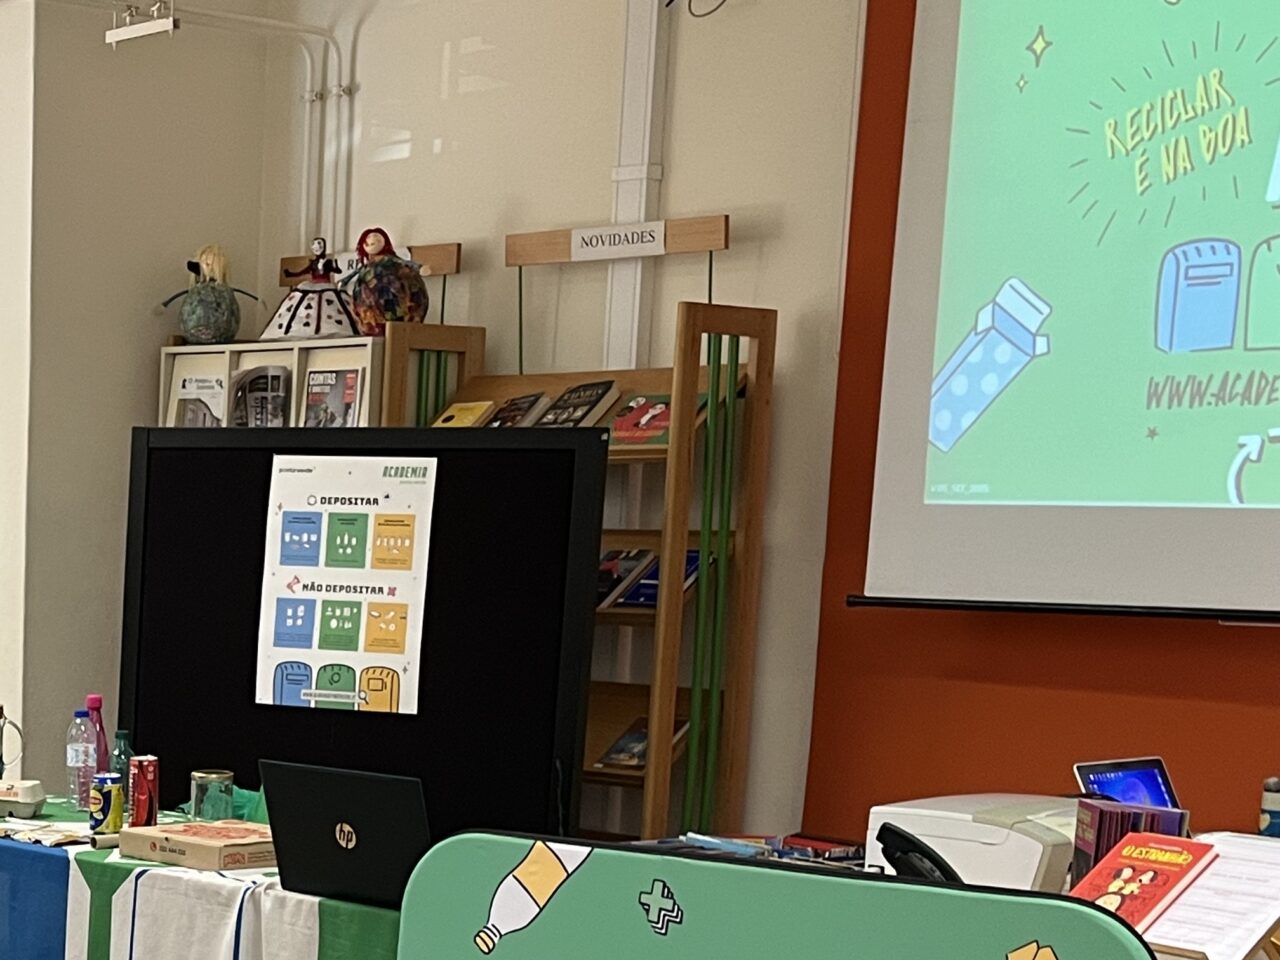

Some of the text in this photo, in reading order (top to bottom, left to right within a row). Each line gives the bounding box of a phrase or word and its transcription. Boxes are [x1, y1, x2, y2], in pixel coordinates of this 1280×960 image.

[1105, 68, 1236, 160] RECICLAR
[1161, 135, 1195, 185] NA
[1200, 105, 1253, 165] BOA
[580, 229, 657, 249] NOVIDADES
[382, 465, 429, 479] ACADEMIA
[320, 496, 380, 506] DEPOSITAR
[302, 581, 384, 595] NÃO DEPOSITAR
[337, 823, 354, 850] hp
